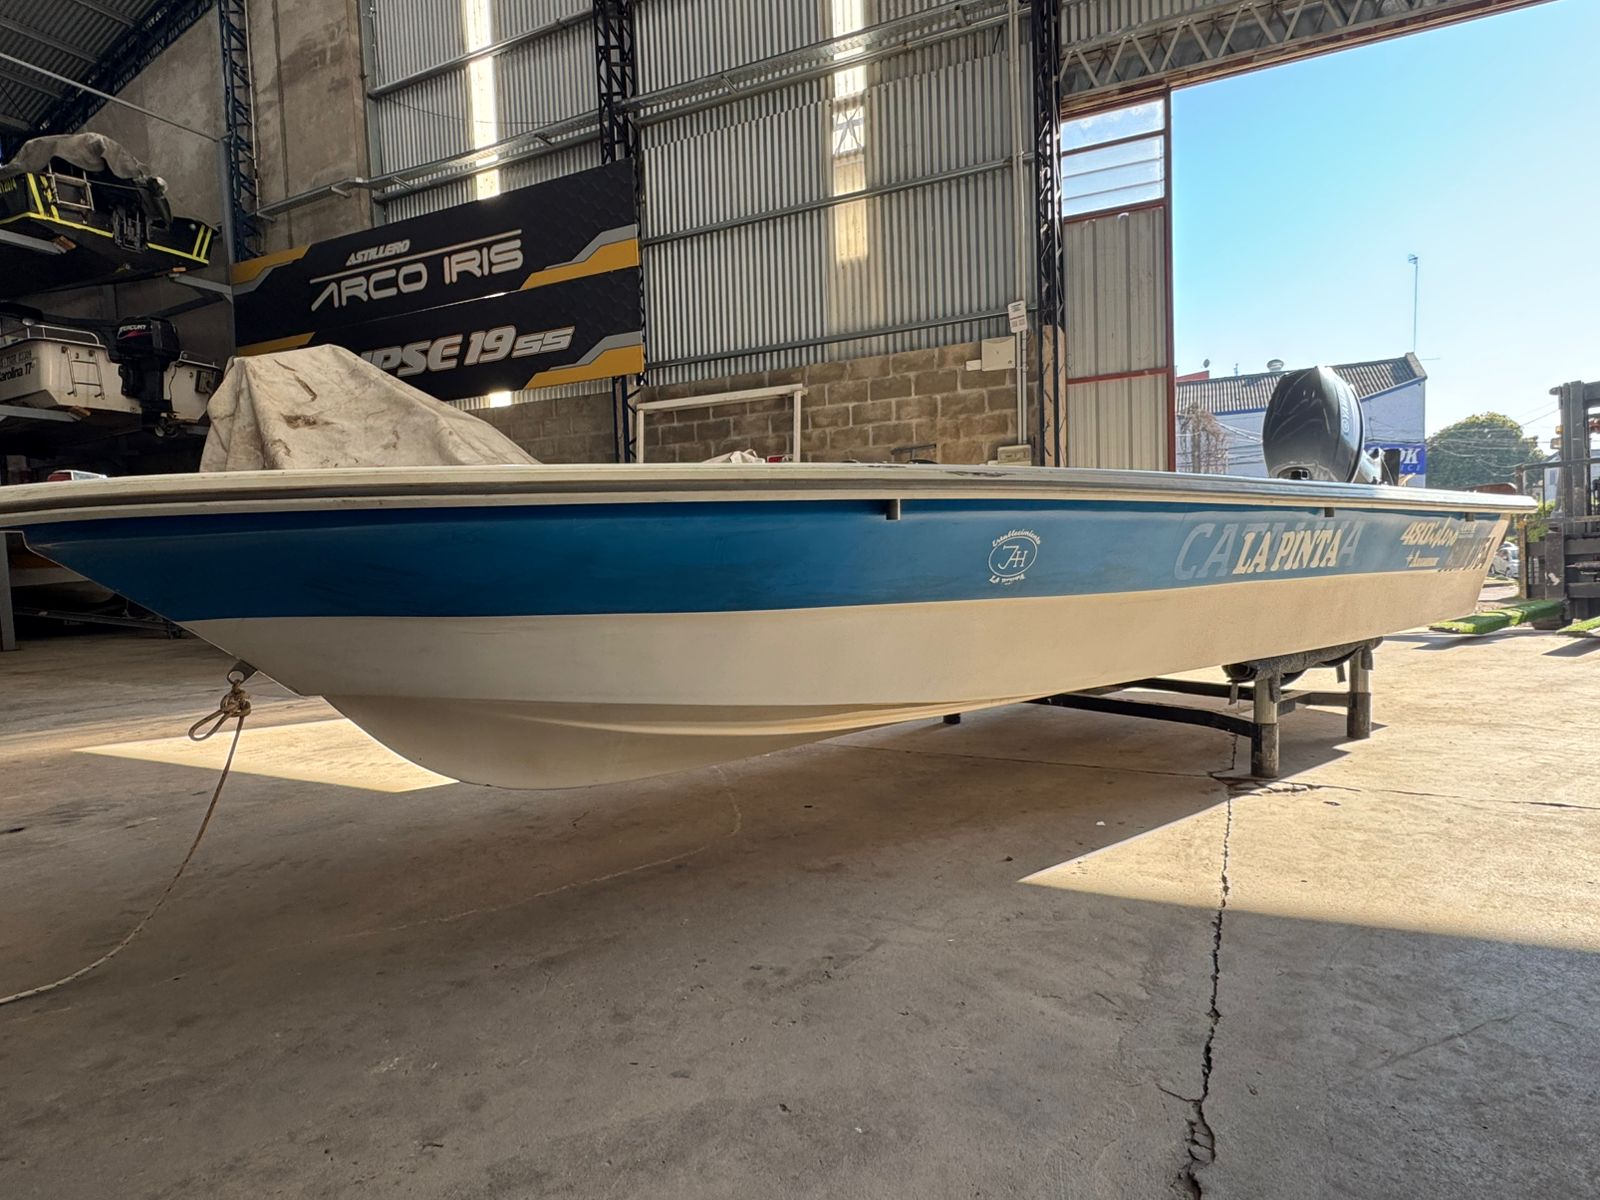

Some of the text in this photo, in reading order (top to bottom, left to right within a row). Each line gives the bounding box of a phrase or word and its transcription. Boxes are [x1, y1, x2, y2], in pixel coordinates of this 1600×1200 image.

[310, 239, 524, 312] ARCO IRIS
[345, 239, 411, 266] ASTILLERO
[1232, 528, 1343, 574] LA PINTA
